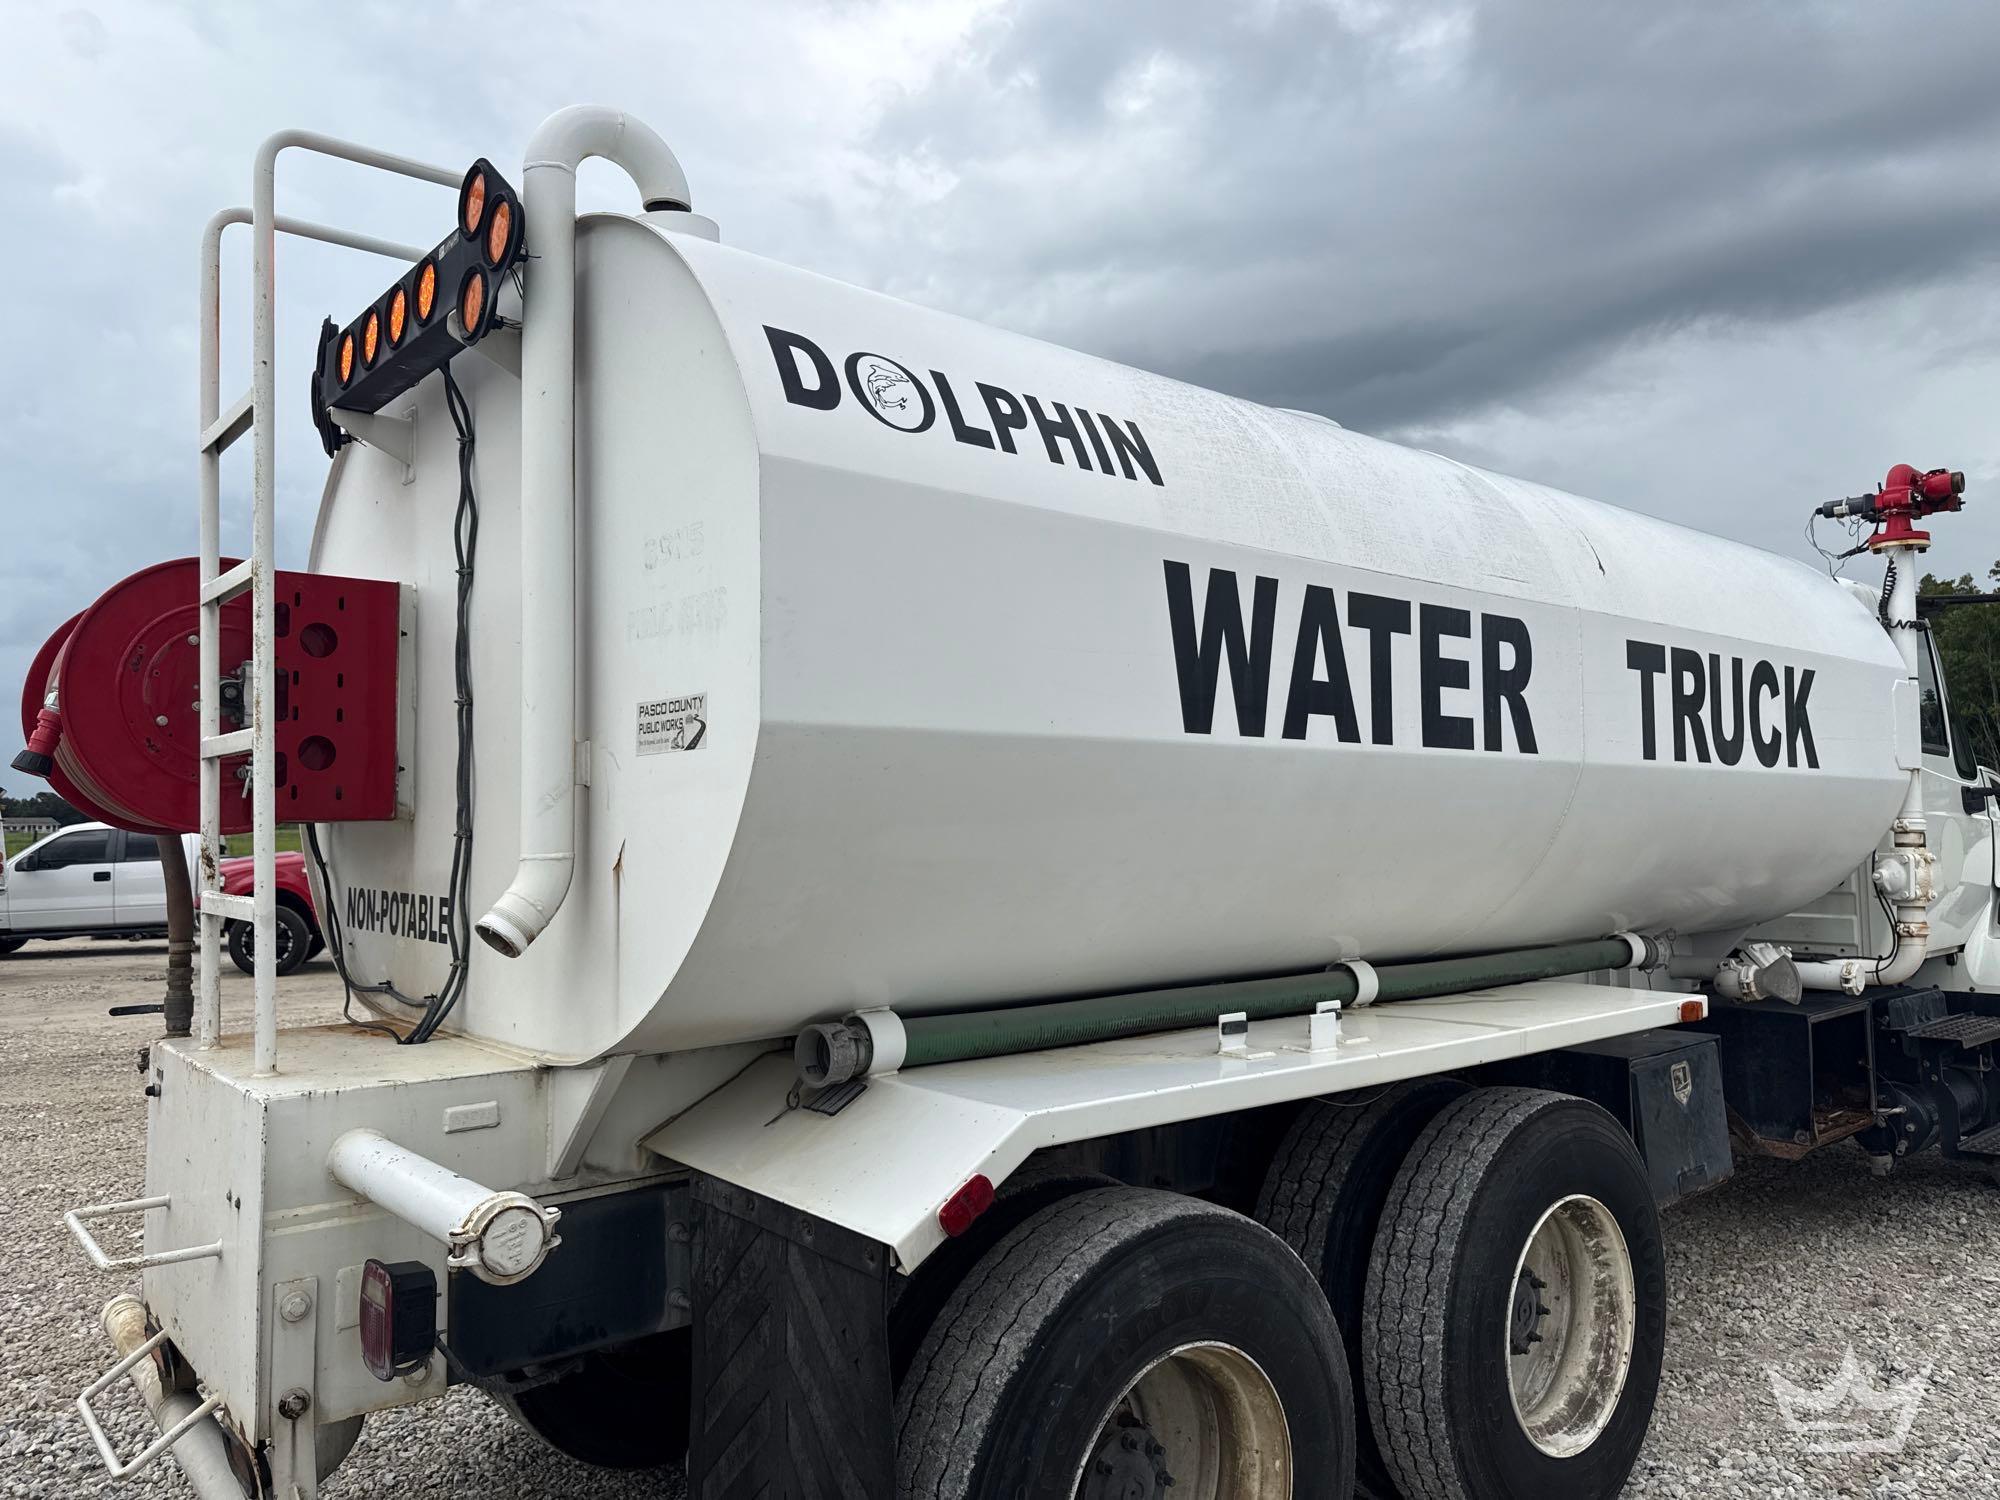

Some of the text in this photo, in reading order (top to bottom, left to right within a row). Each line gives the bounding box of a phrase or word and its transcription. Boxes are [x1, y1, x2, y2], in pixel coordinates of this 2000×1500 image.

[762, 324, 1165, 487] DOLPHIN
[1163, 559, 1819, 769] WATER TRUCK
[639, 695, 704, 718] PASCO COUNTY
[639, 717, 684, 735] PUBLIC WORKS
[346, 886, 449, 945] NON-POTABLE
